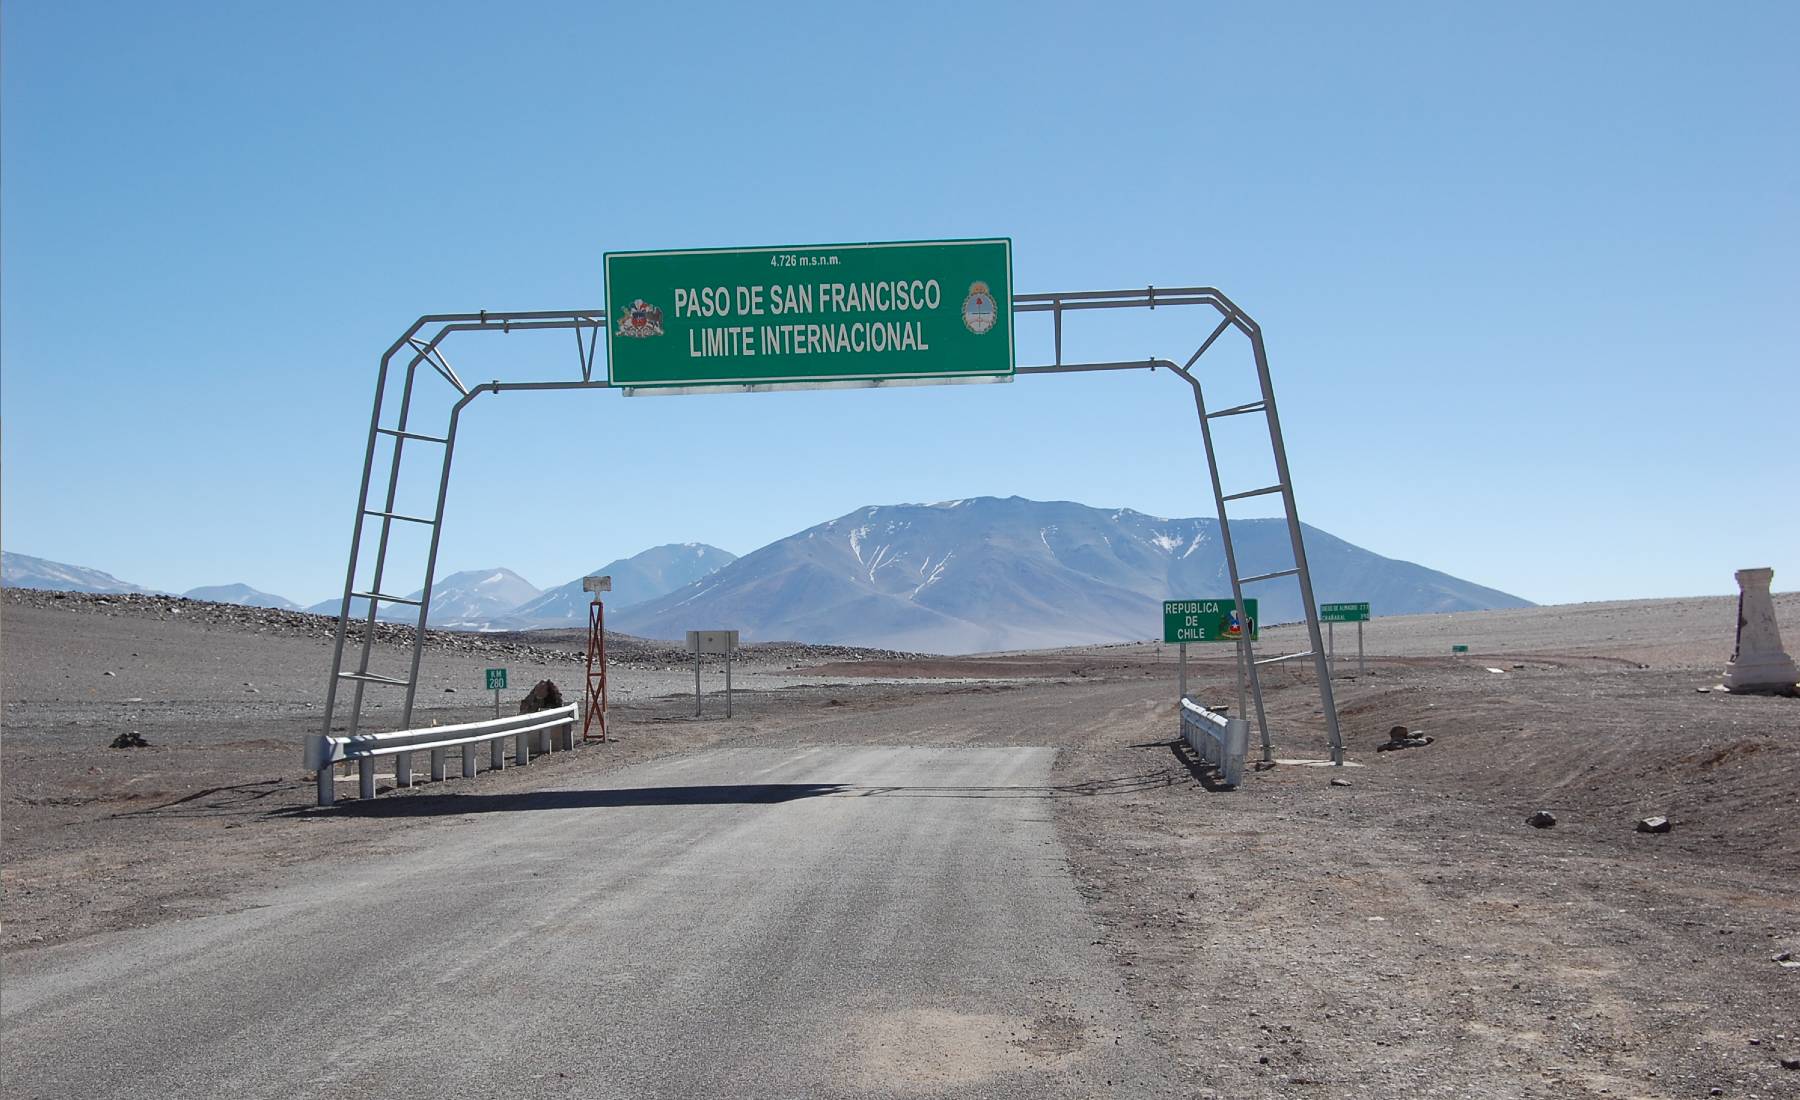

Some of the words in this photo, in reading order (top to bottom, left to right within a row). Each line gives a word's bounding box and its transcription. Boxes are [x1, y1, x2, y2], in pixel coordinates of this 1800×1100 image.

[770, 255, 797, 267] 4.726
[799, 255, 841, 266] m.s.n.m.
[674, 287, 730, 318] PASO
[736, 285, 764, 316] DE
[770, 283, 813, 315] SAN
[819, 279, 941, 313] FRANCISCO
[689, 327, 755, 358] LIMITE
[761, 321, 929, 356] INTERNACIONAL
[1165, 602, 1219, 614] REPUBLICA
[1185, 615, 1198, 627] DE
[1177, 628, 1205, 639] CHILE
[489, 679, 504, 689] 280
